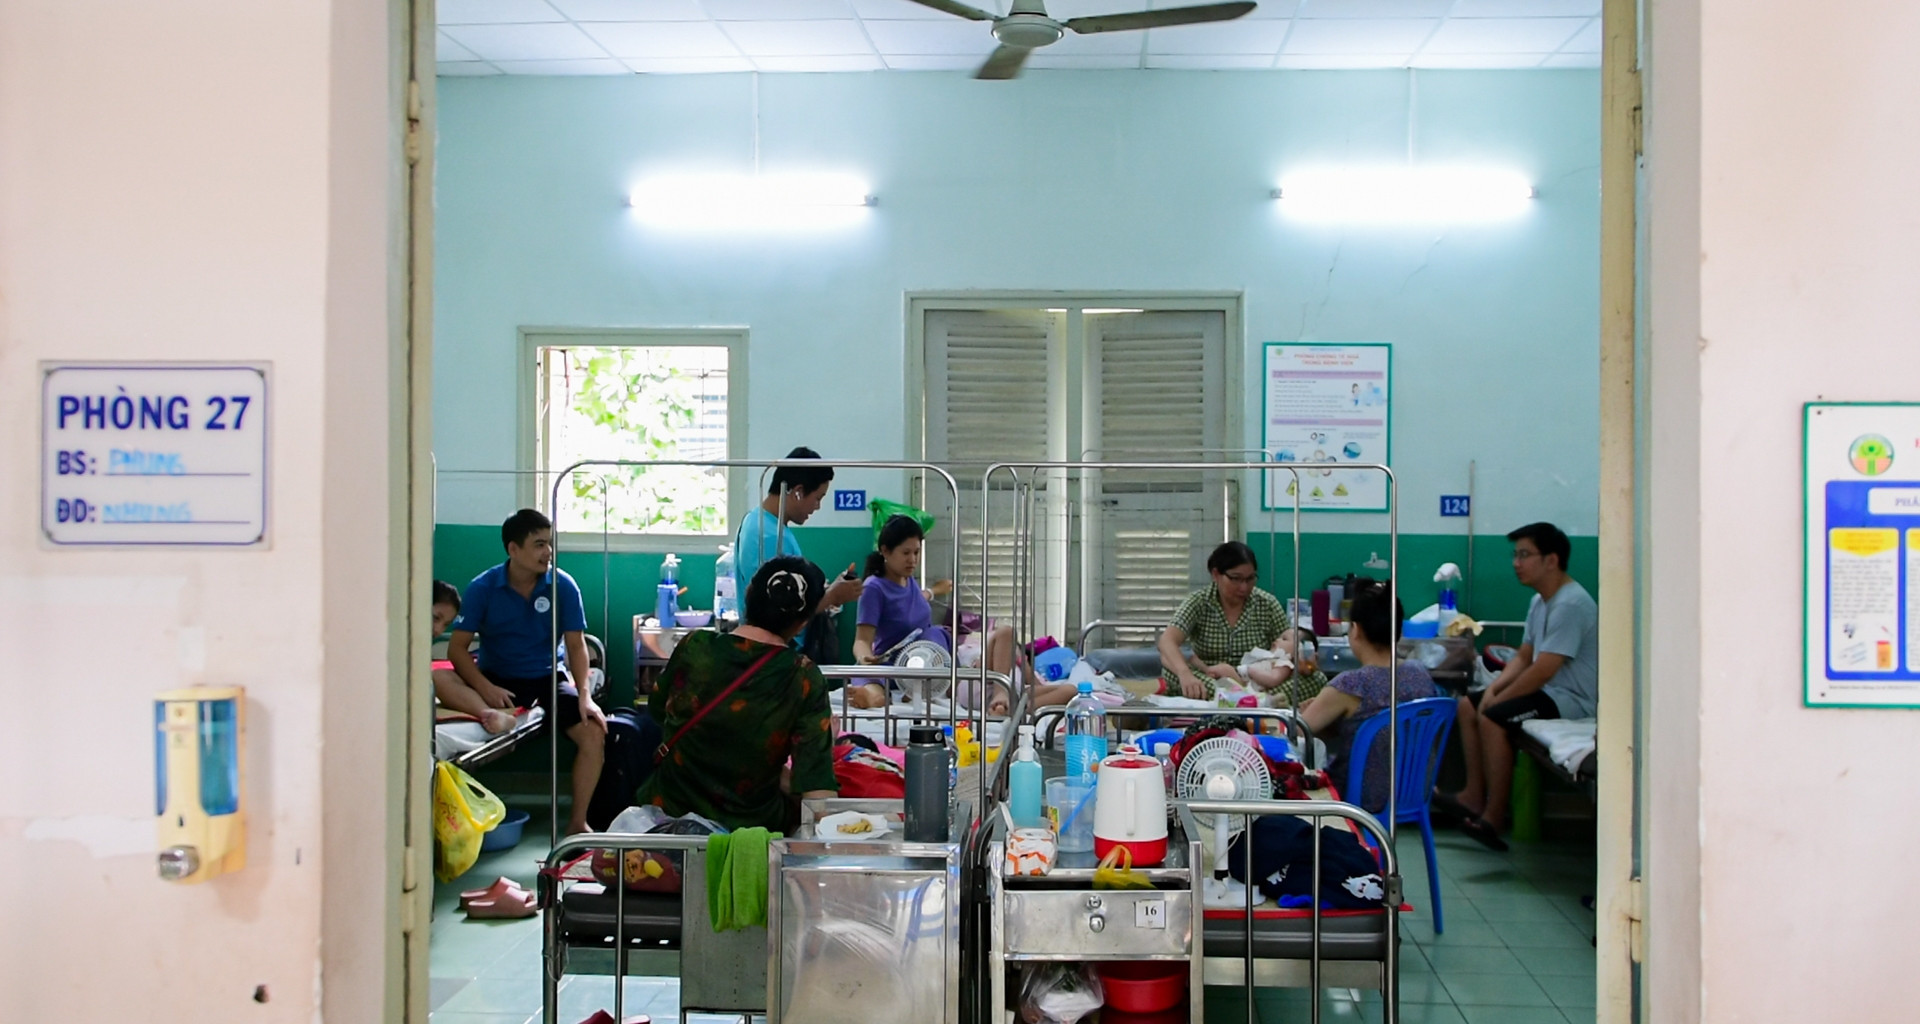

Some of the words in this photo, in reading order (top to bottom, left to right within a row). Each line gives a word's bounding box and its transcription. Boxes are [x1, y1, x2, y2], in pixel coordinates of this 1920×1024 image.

[57, 385, 189, 430] PHÒNG
[205, 396, 251, 430] 27
[57, 450, 96, 475] BS:
[56, 498, 95, 523] ĐD:
[838, 493, 862, 508] 123
[1444, 498, 1468, 514] 124
[1145, 905, 1157, 916] 16
